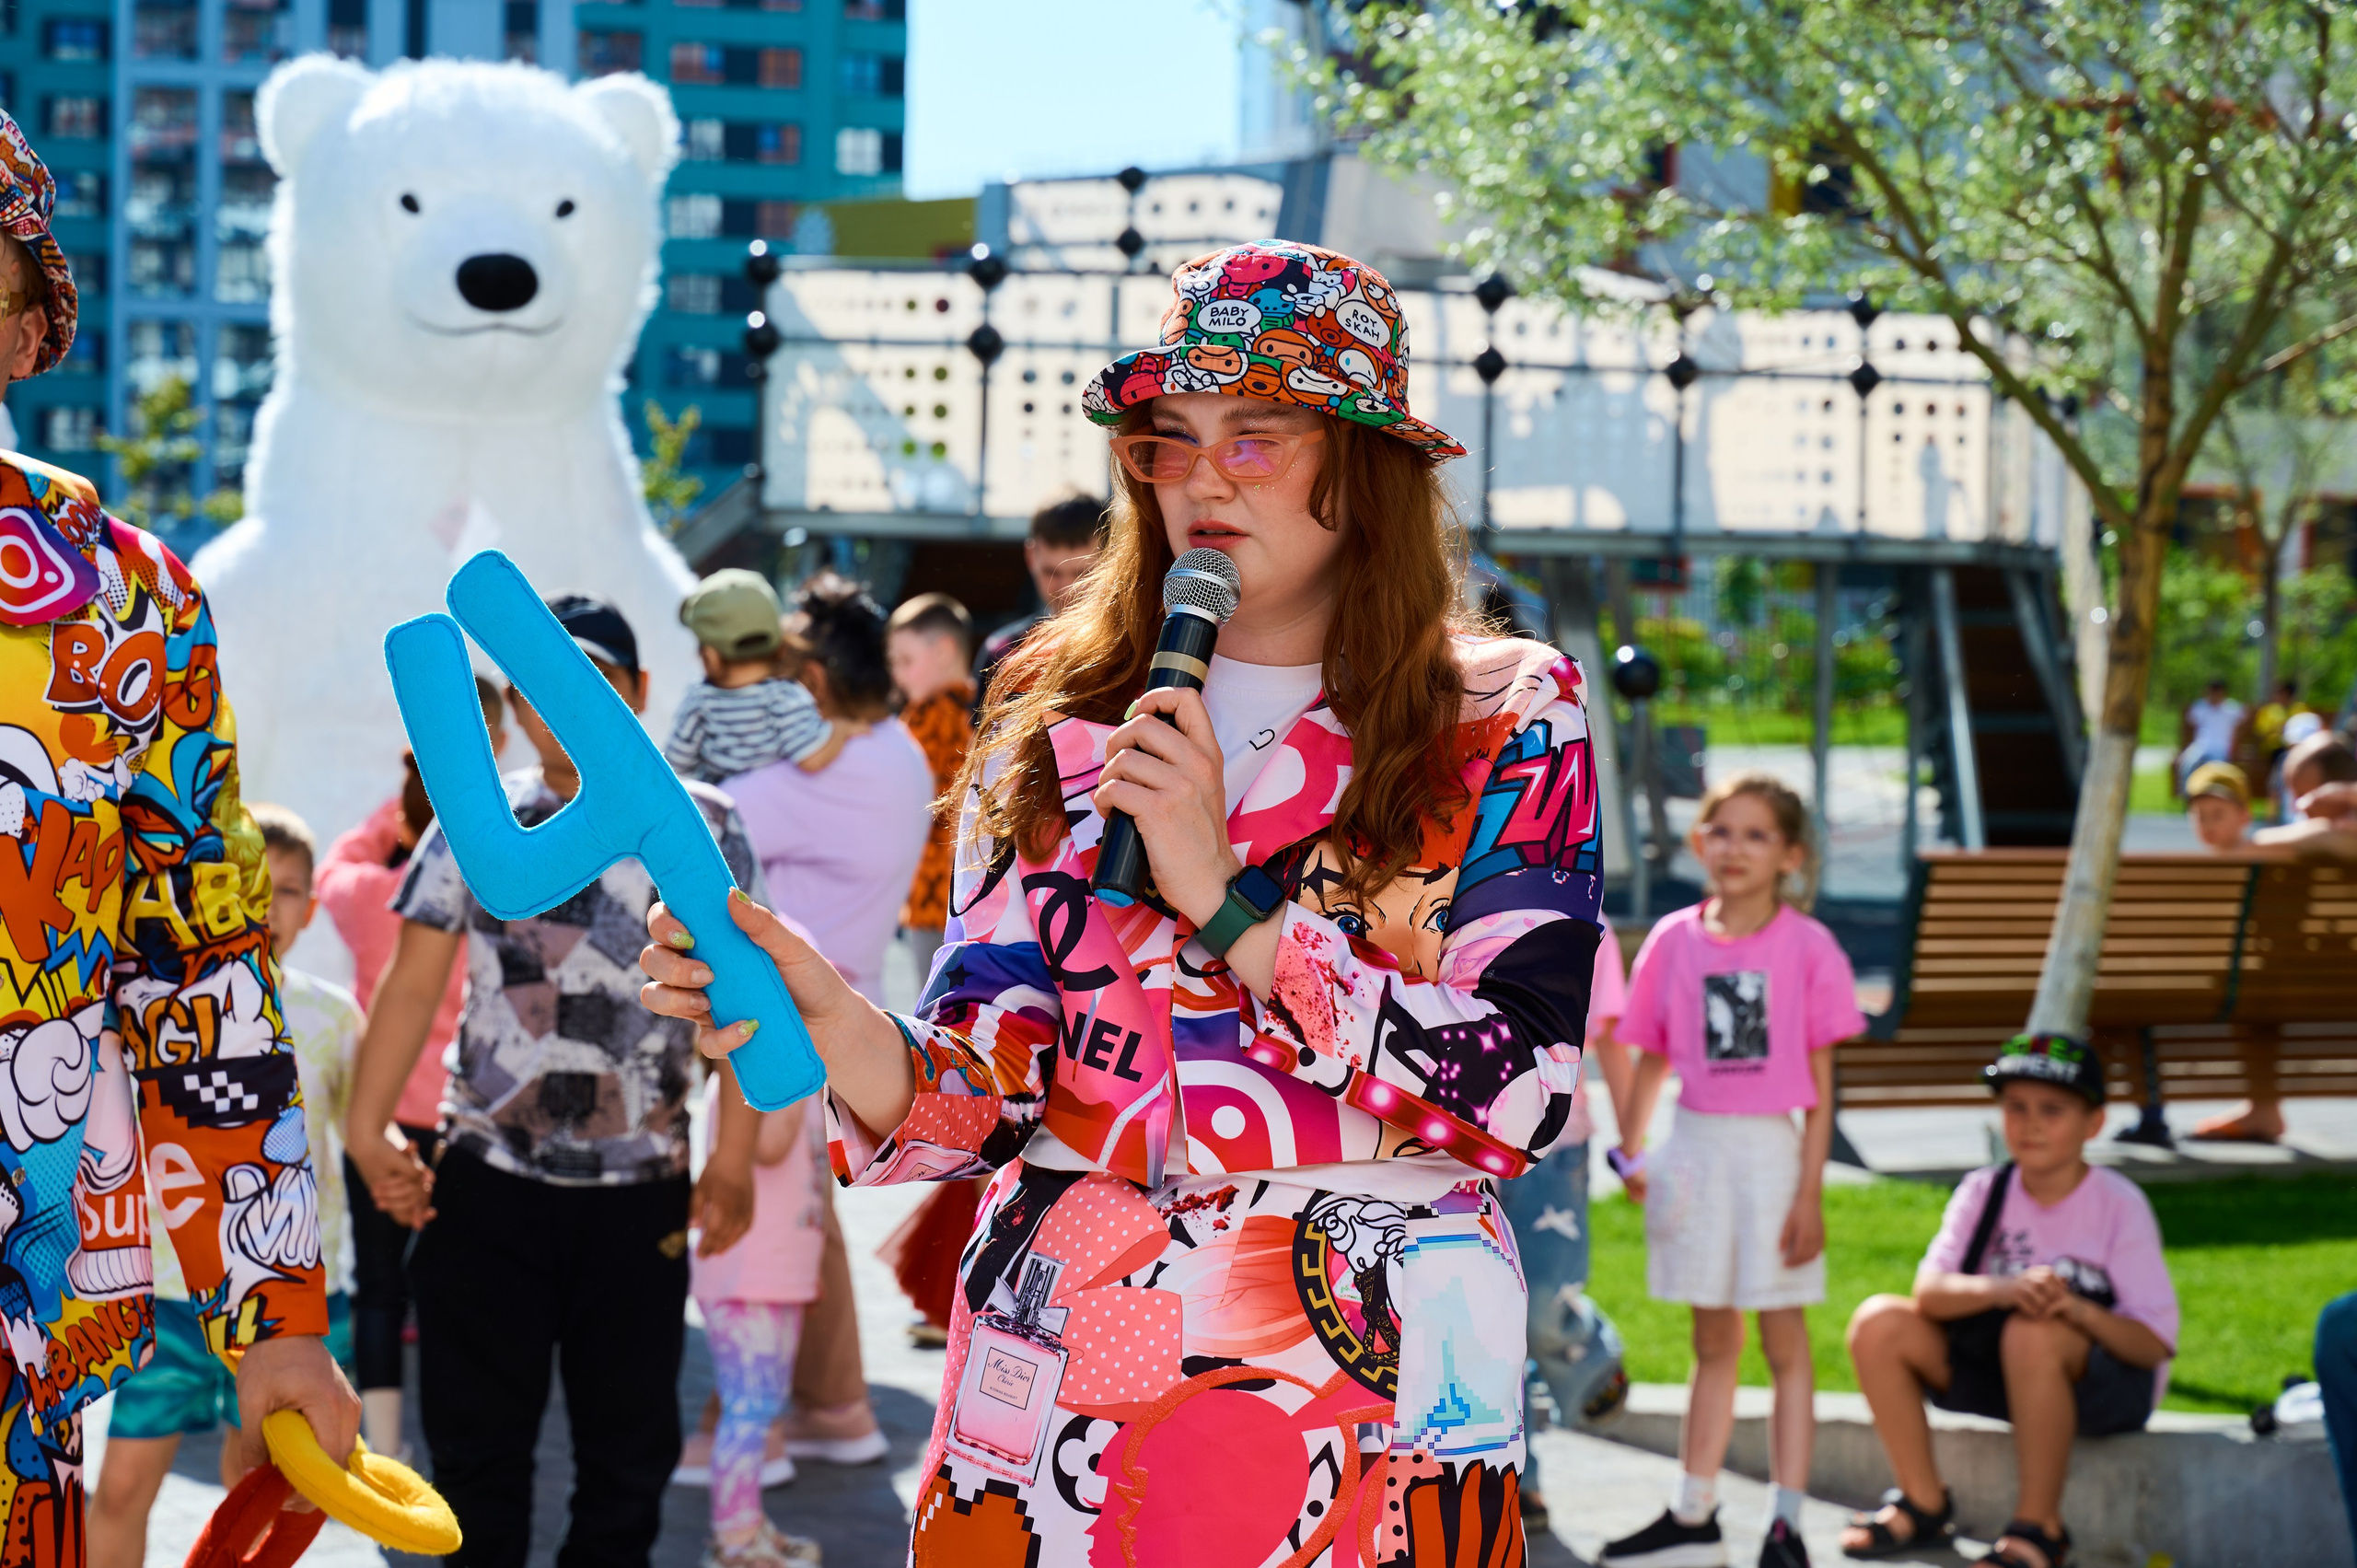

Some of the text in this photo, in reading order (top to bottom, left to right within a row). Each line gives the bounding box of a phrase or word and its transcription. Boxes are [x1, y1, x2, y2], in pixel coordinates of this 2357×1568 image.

[1208, 317, 1247, 327] MILO
[1210, 306, 1249, 317] BABY
[1352, 308, 1377, 328] ROY
[1344, 318, 1380, 342] SKAH
[1060, 1003, 1144, 1084] NEL
[46, 1295, 150, 1391] BANG!
[987, 1358, 1030, 1383] Miss Dior
